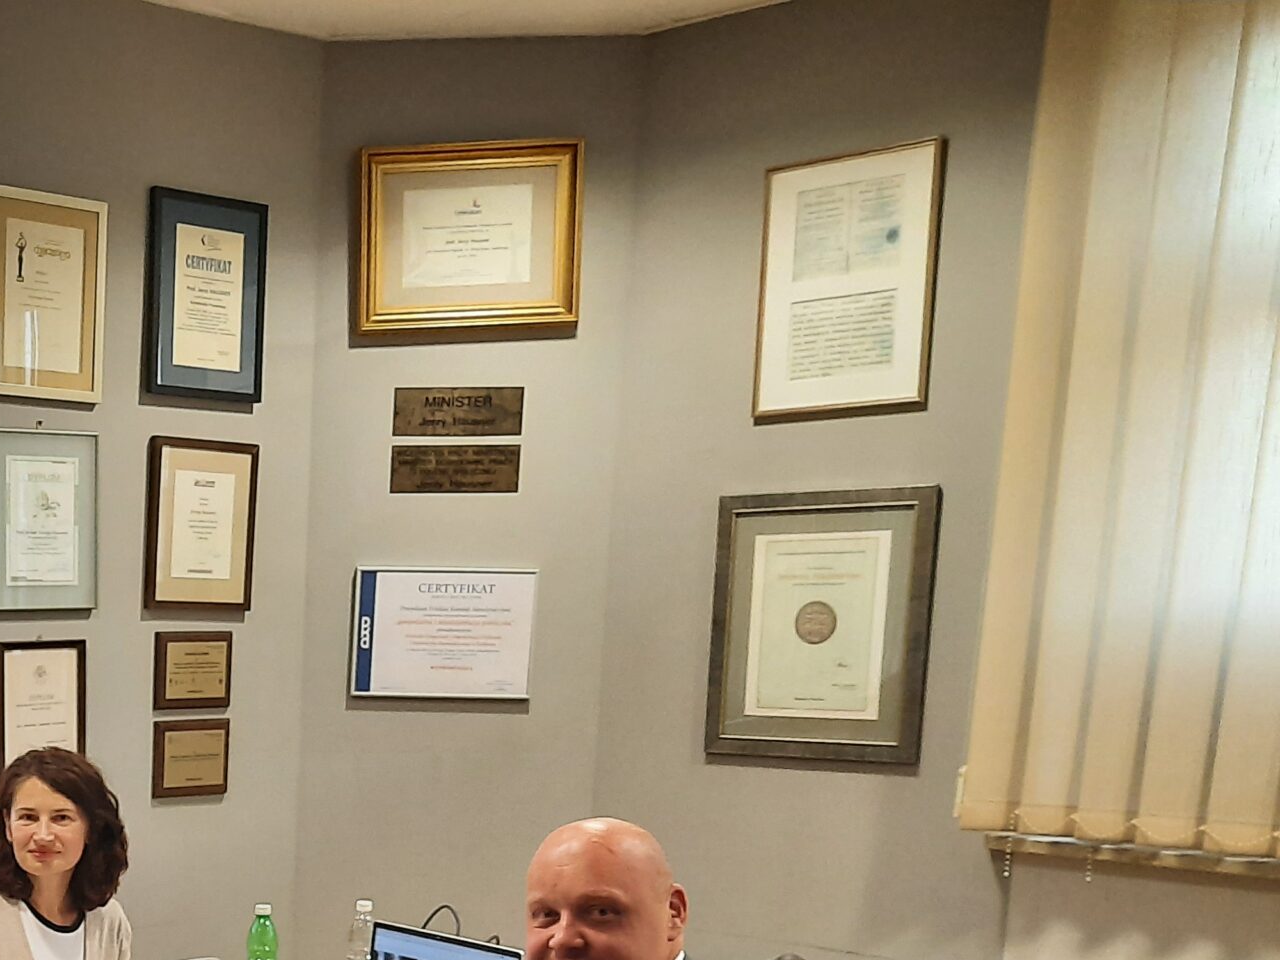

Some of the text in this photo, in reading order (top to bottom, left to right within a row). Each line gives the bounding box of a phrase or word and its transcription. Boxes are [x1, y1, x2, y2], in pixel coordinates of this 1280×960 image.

[185, 254, 232, 275] CERTYFIKAT
[424, 395, 492, 408] MINISTER
[418, 583, 497, 594] CERTYFIKAT
